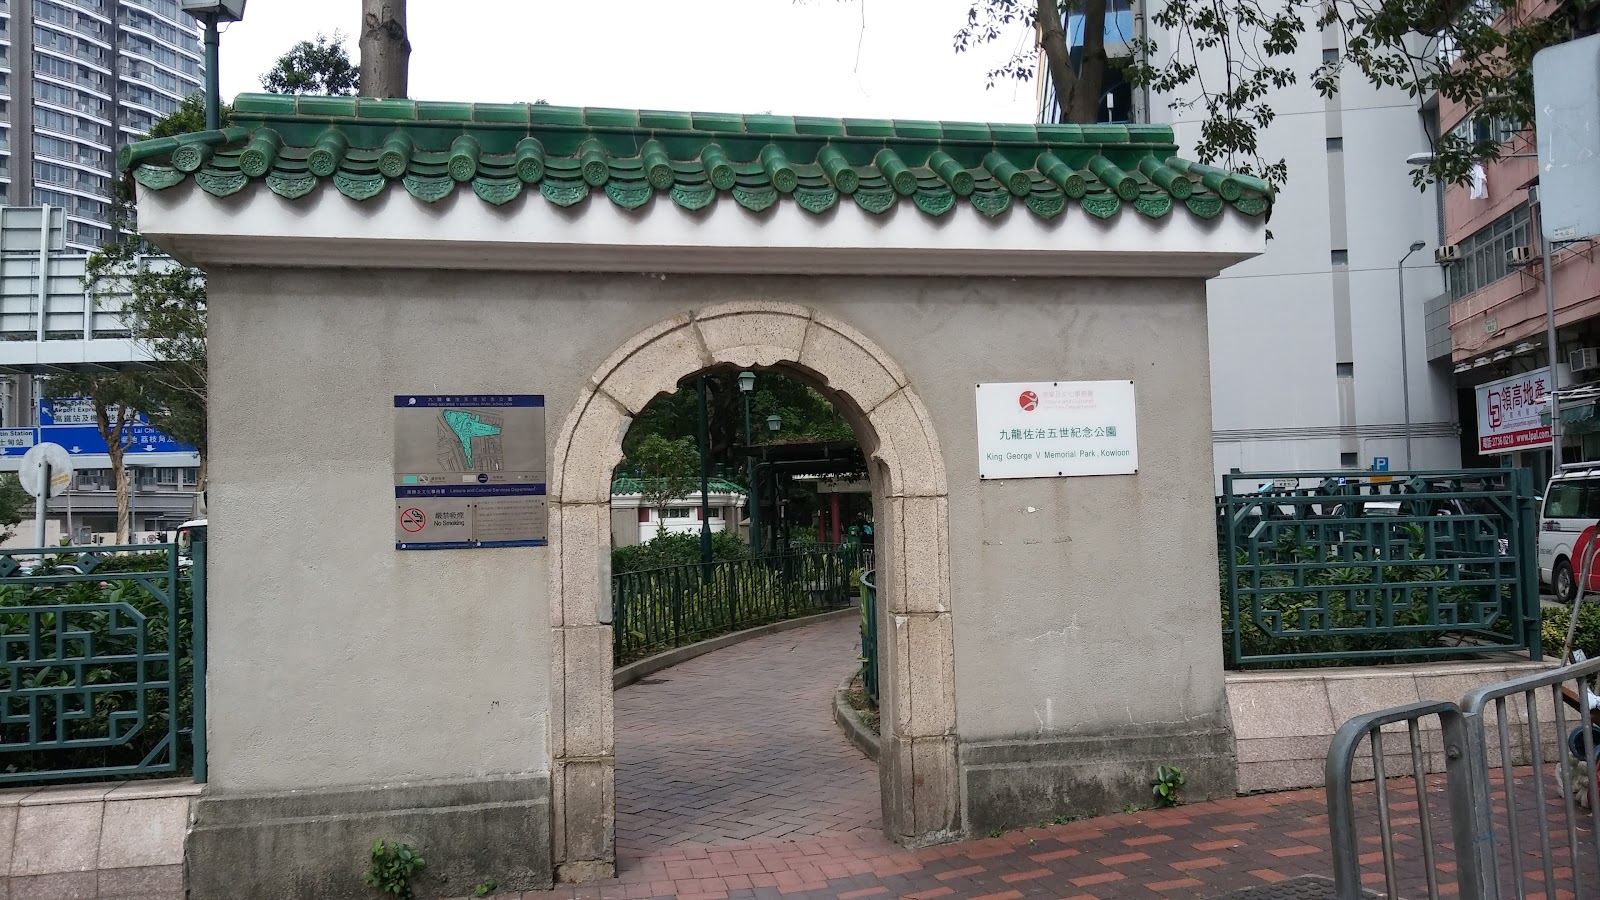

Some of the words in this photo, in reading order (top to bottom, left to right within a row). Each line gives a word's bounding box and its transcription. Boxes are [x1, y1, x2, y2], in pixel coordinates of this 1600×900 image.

[1501, 379, 1546, 411] 領高地產
[999, 426, 1117, 440] 九龍佐治五世紀念公園
[986, 453, 1003, 461] King
[1006, 452, 1032, 461] George
[1044, 450, 1076, 459] Memorial
[1100, 449, 1130, 457] Kowloon
